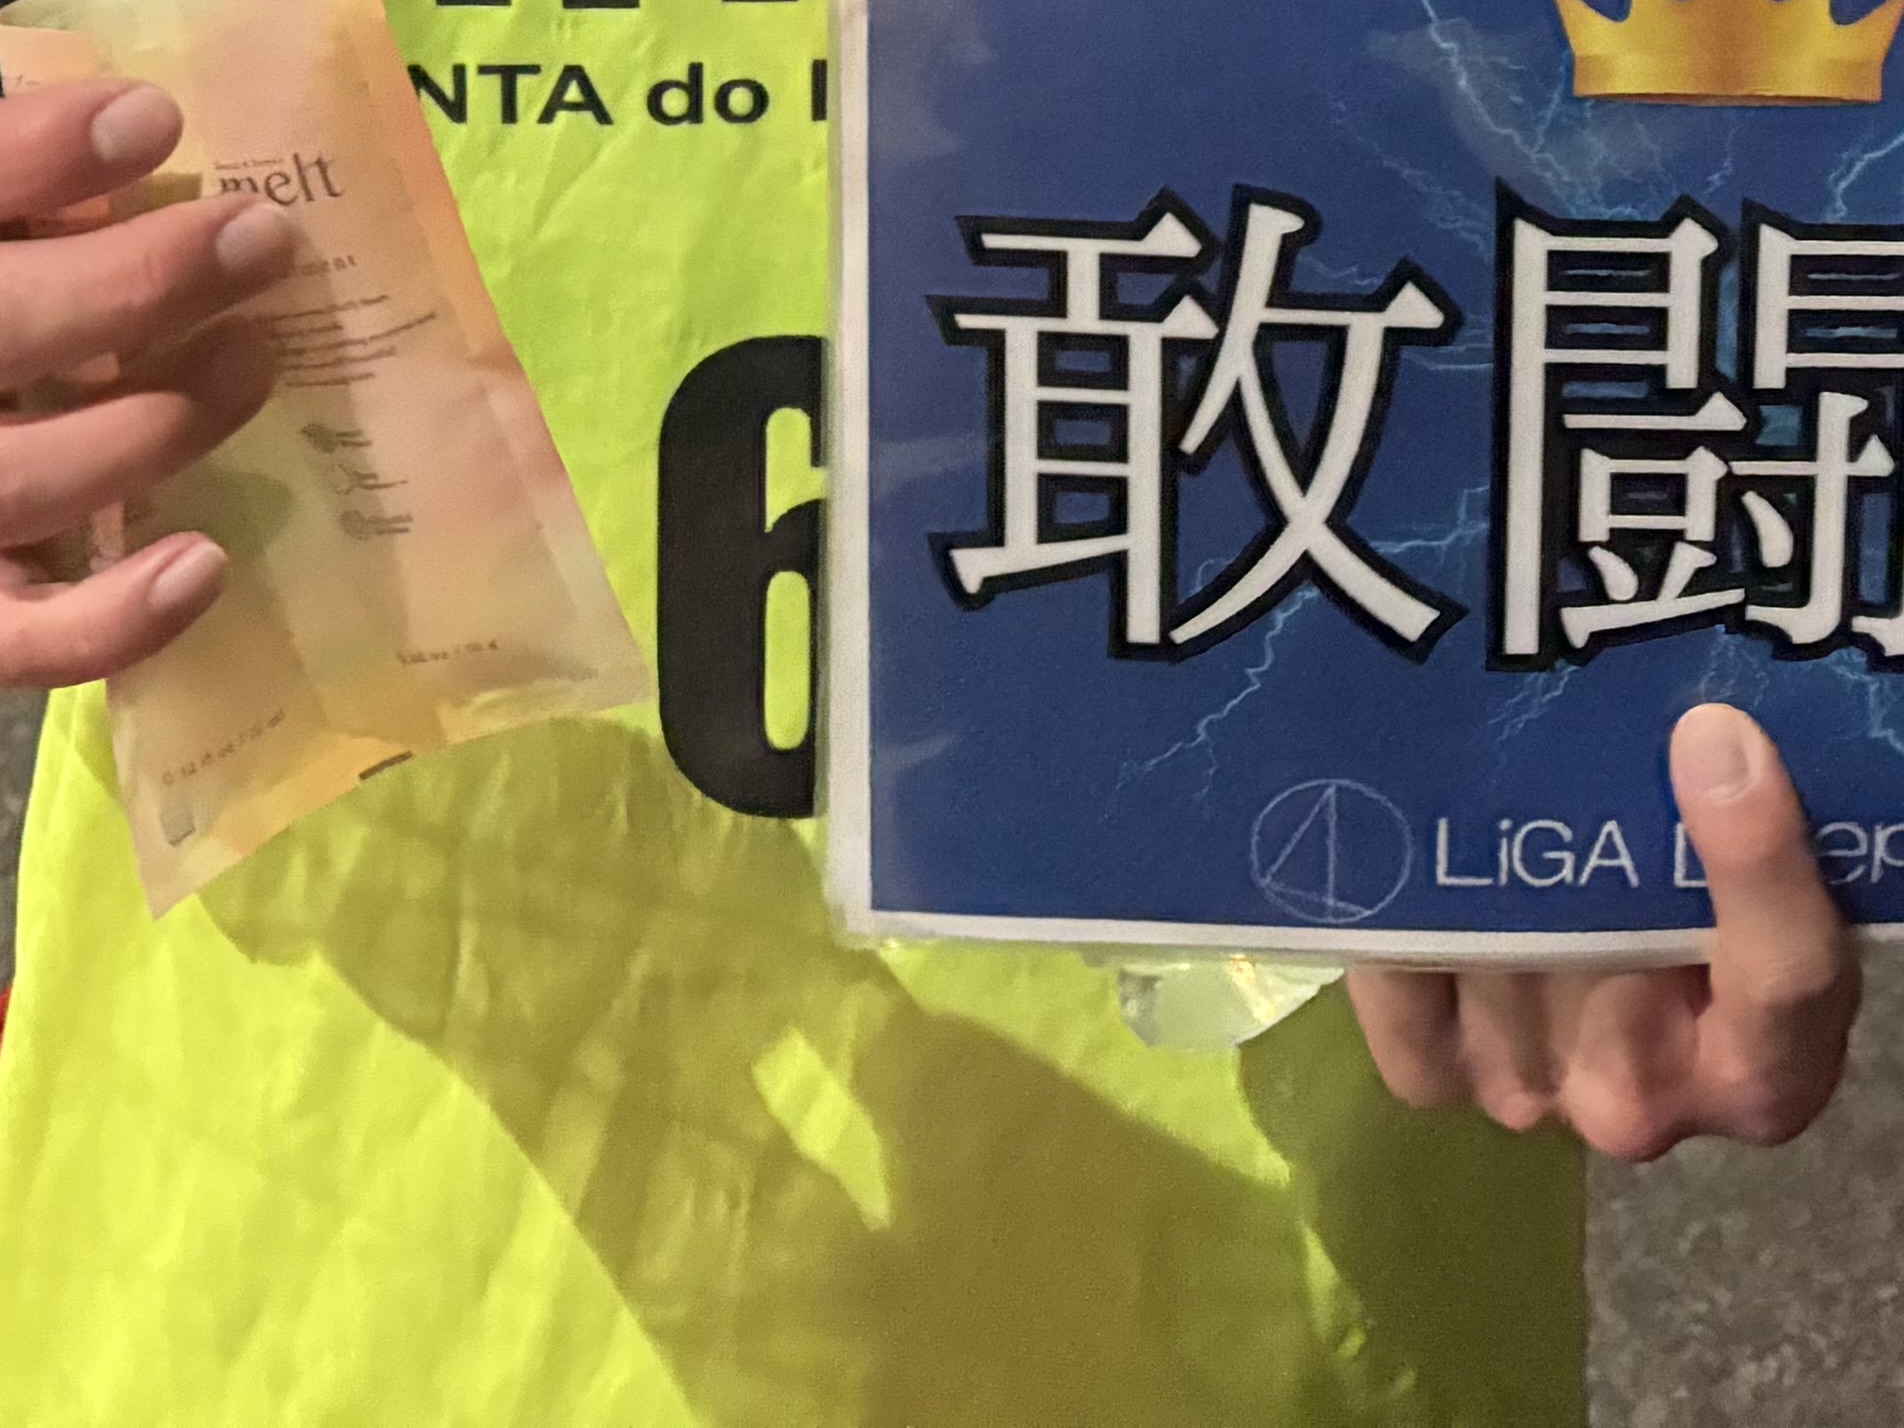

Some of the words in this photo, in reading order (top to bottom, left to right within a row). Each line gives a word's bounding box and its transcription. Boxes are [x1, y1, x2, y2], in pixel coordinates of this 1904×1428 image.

[646, 61, 771, 126] do
[217, 152, 346, 207] melt
[656, 334, 829, 821] 6
